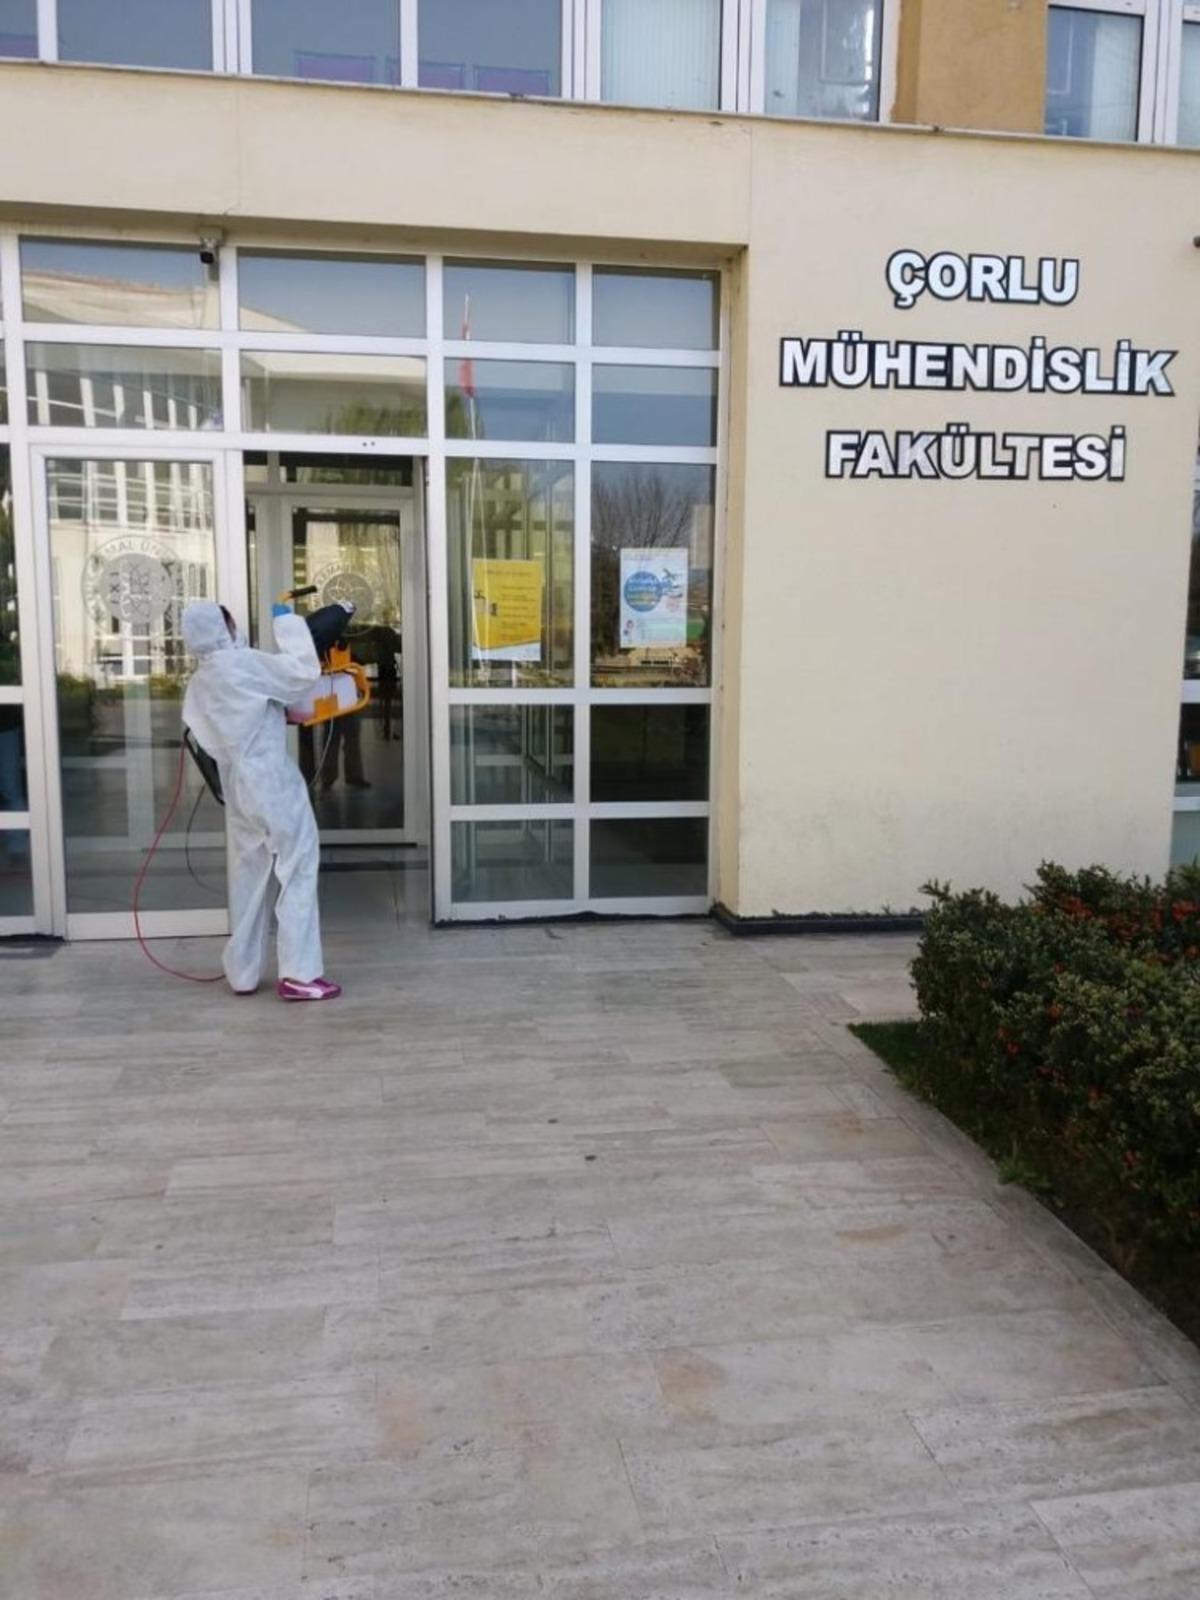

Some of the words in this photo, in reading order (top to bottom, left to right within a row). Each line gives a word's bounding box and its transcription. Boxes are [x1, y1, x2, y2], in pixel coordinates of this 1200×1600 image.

[886, 249, 1079, 309] ÇORLU
[779, 330, 1179, 397] MÜHENDİSLİK
[825, 422, 1125, 482] FAKÜLTESİ
